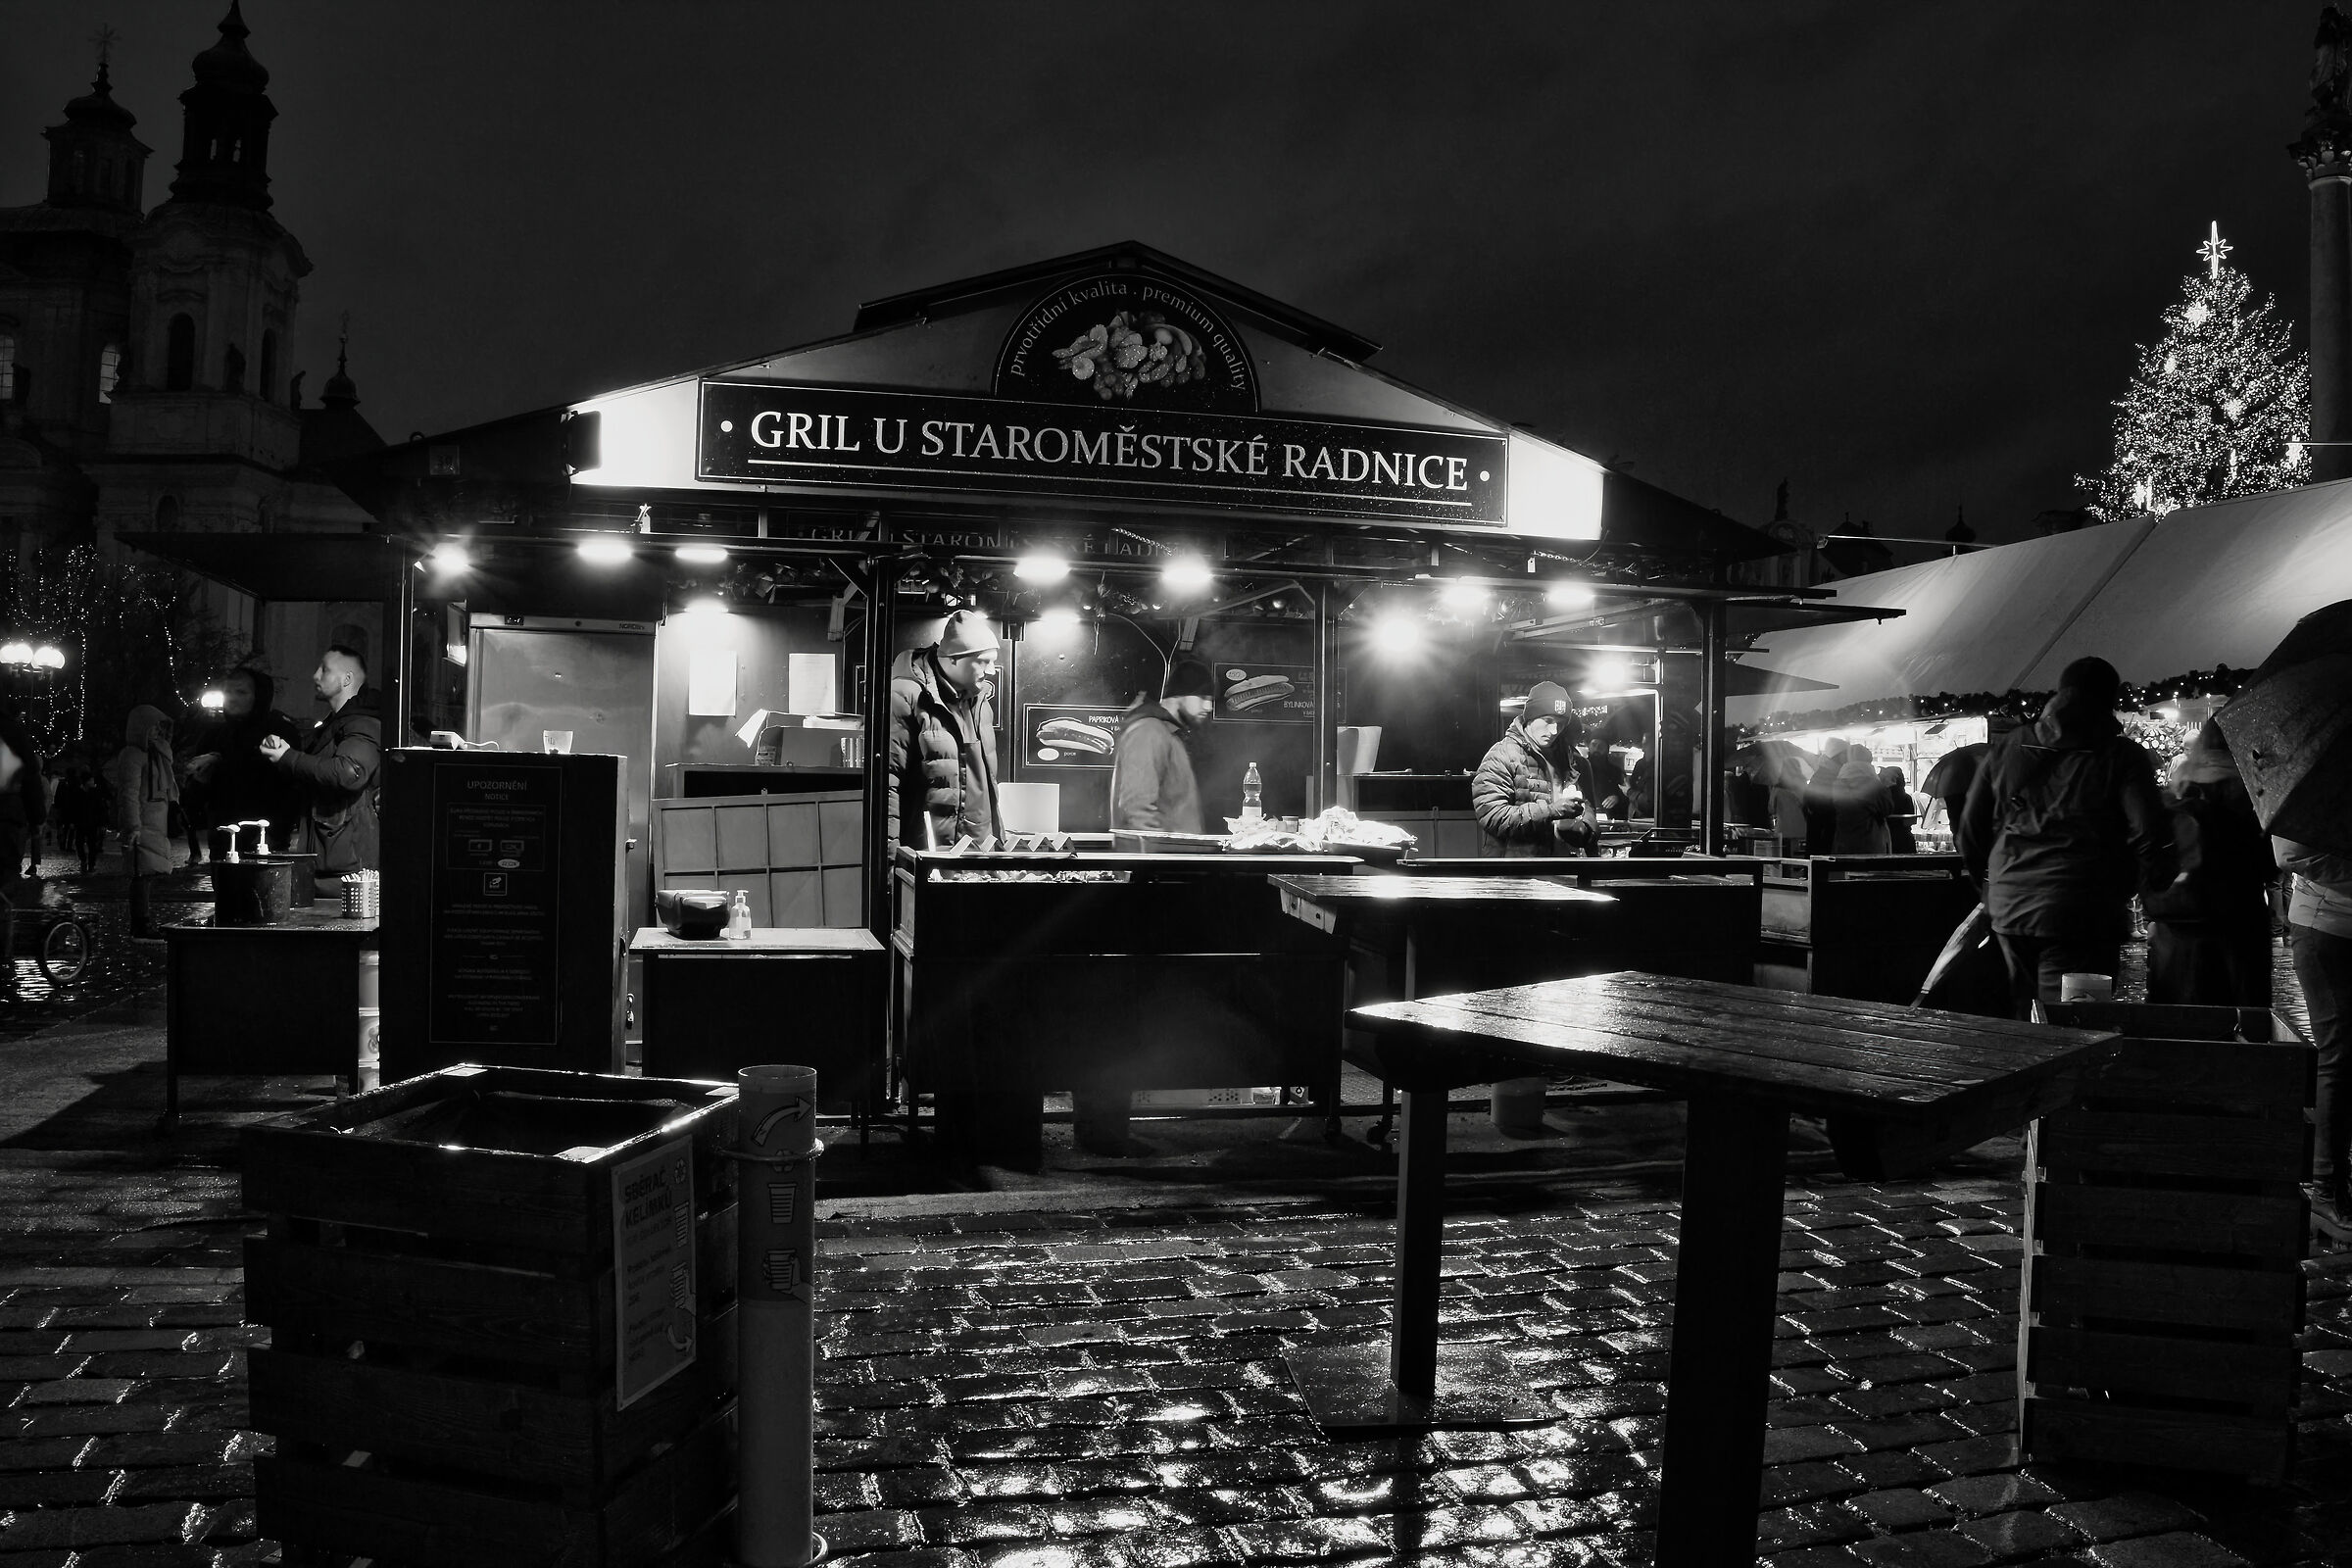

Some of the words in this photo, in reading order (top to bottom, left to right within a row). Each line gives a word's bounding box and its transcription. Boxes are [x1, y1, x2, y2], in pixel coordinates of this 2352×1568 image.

[1010, 296, 1068, 376] prvotřídní
[1068, 280, 1127, 306] kvalita
[1143, 284, 1215, 334] premium
[1213, 332, 1247, 391] quality
[751, 410, 859, 452] GRIL
[872, 416, 907, 455] U
[921, 419, 1268, 476] STAROMĚSTSKÉ
[1282, 443, 1468, 491] RADNICE
